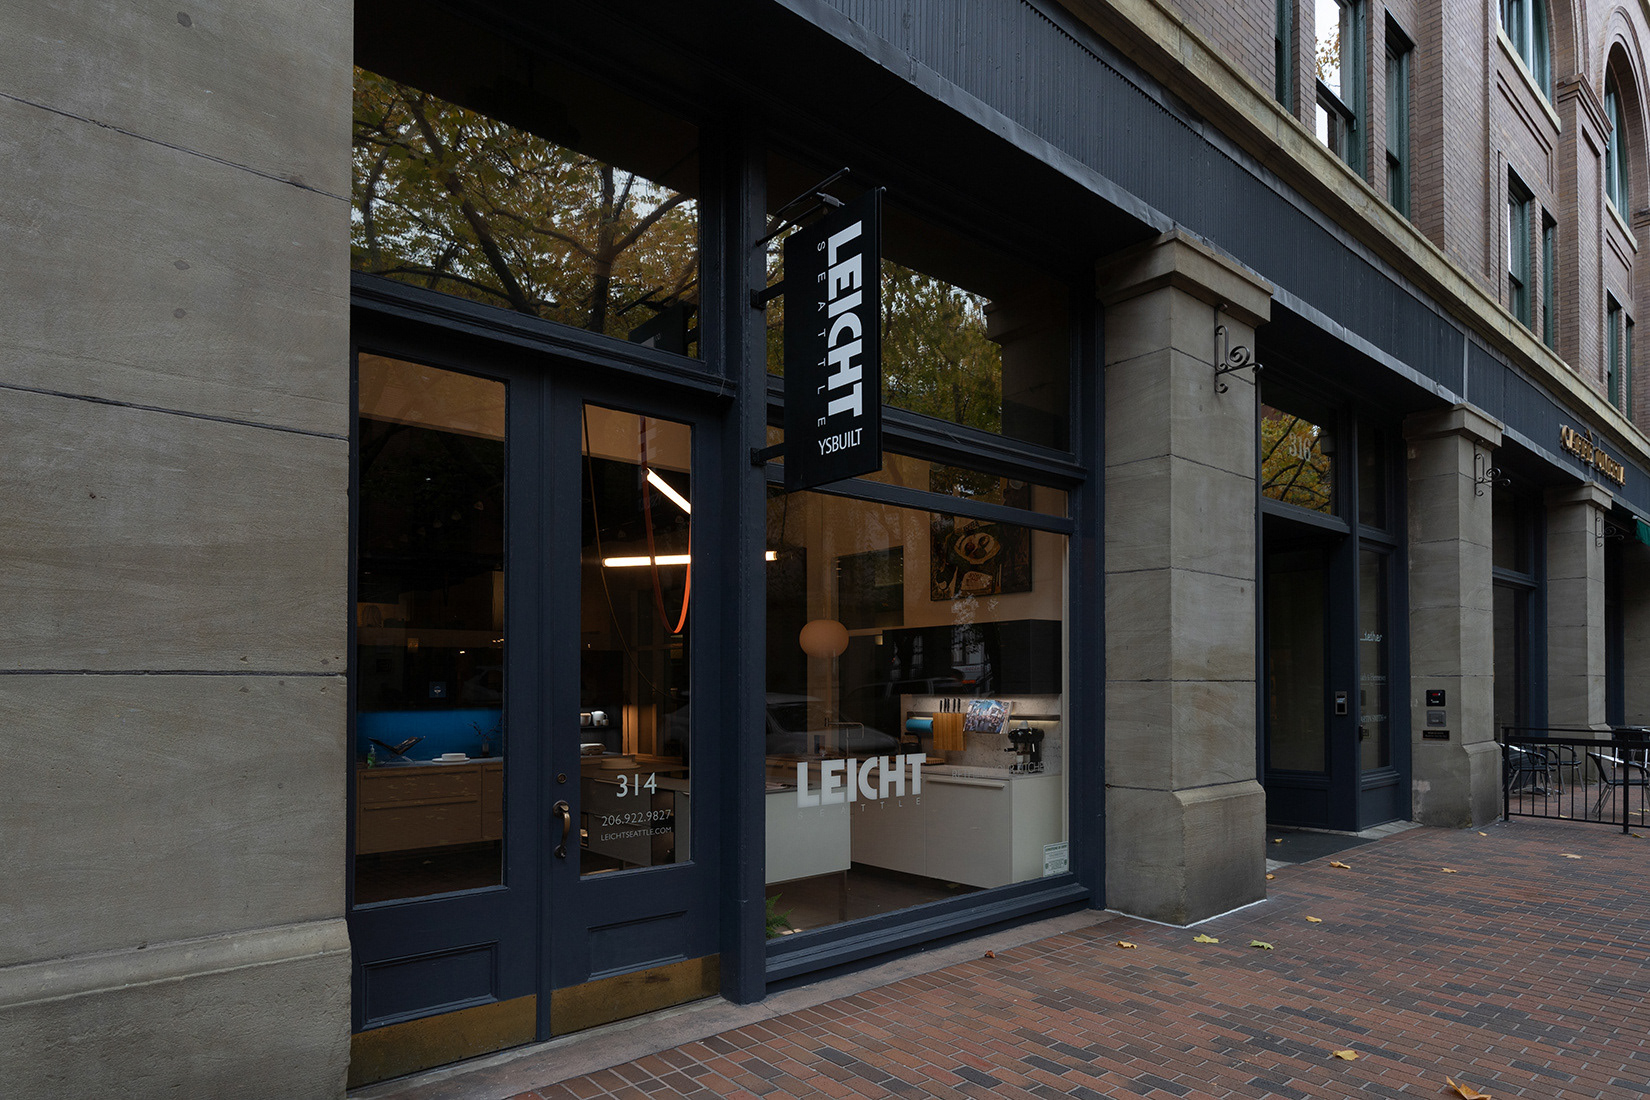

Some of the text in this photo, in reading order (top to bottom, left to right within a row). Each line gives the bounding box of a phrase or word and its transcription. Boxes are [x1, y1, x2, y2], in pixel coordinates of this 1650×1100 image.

[828, 220, 862, 417] LEICHT
[817, 240, 826, 427] SEATTLE
[818, 428, 863, 456] YSBUILT
[1289, 432, 1311, 461] 316
[616, 772, 658, 798] 314
[797, 753, 926, 808] LEICHT
[601, 809, 672, 827] 206.922.9827
[798, 797, 921, 819] SEATTLE
[600, 826, 672, 842] LEICHTSEATTLE.COM
